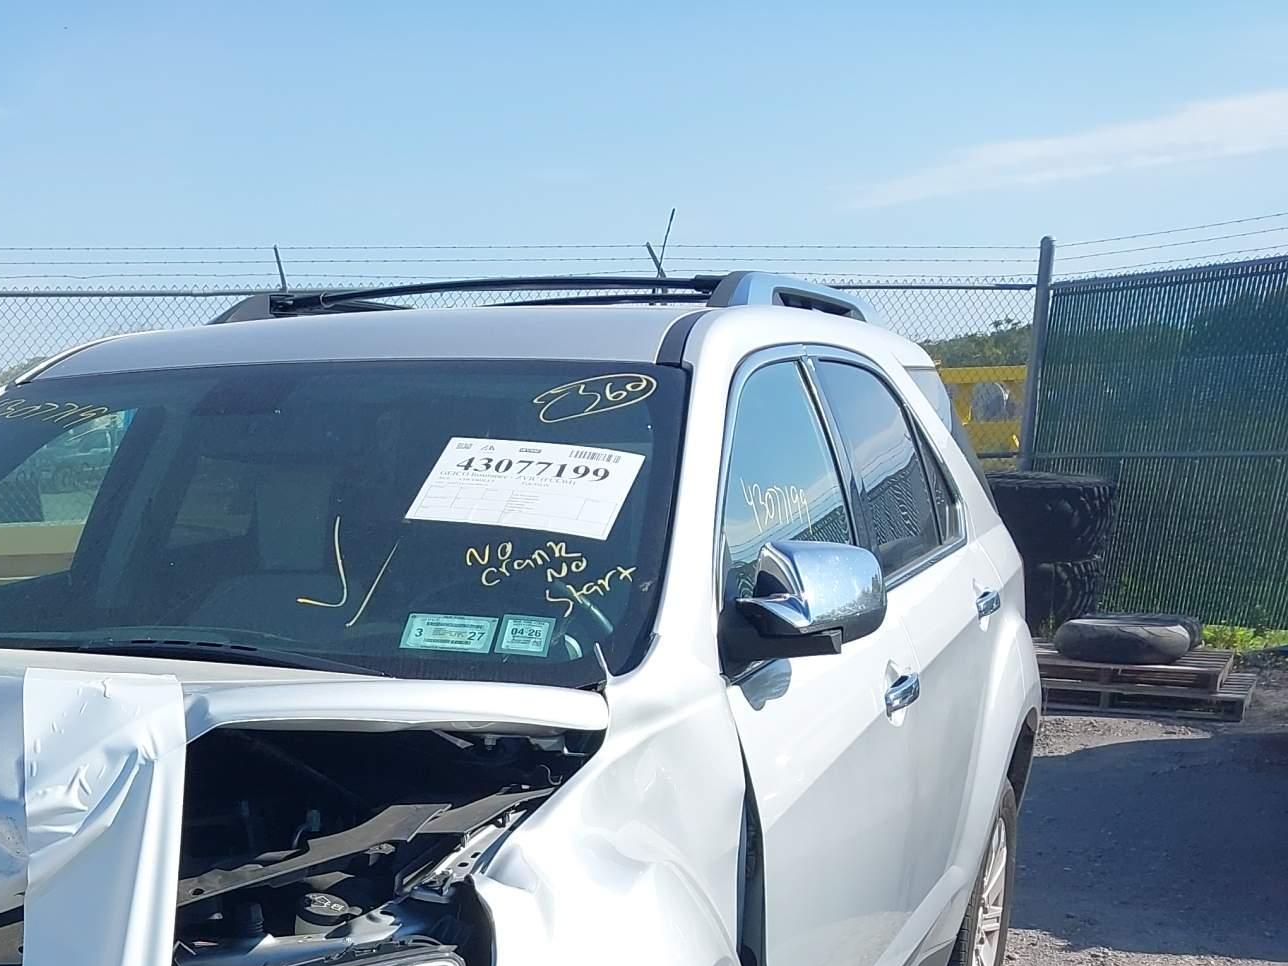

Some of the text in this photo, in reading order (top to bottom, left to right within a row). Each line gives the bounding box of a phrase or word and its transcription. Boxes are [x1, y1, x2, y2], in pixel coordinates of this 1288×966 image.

[456, 456, 610, 482] 43077199
[414, 627, 486, 641] 3 27
